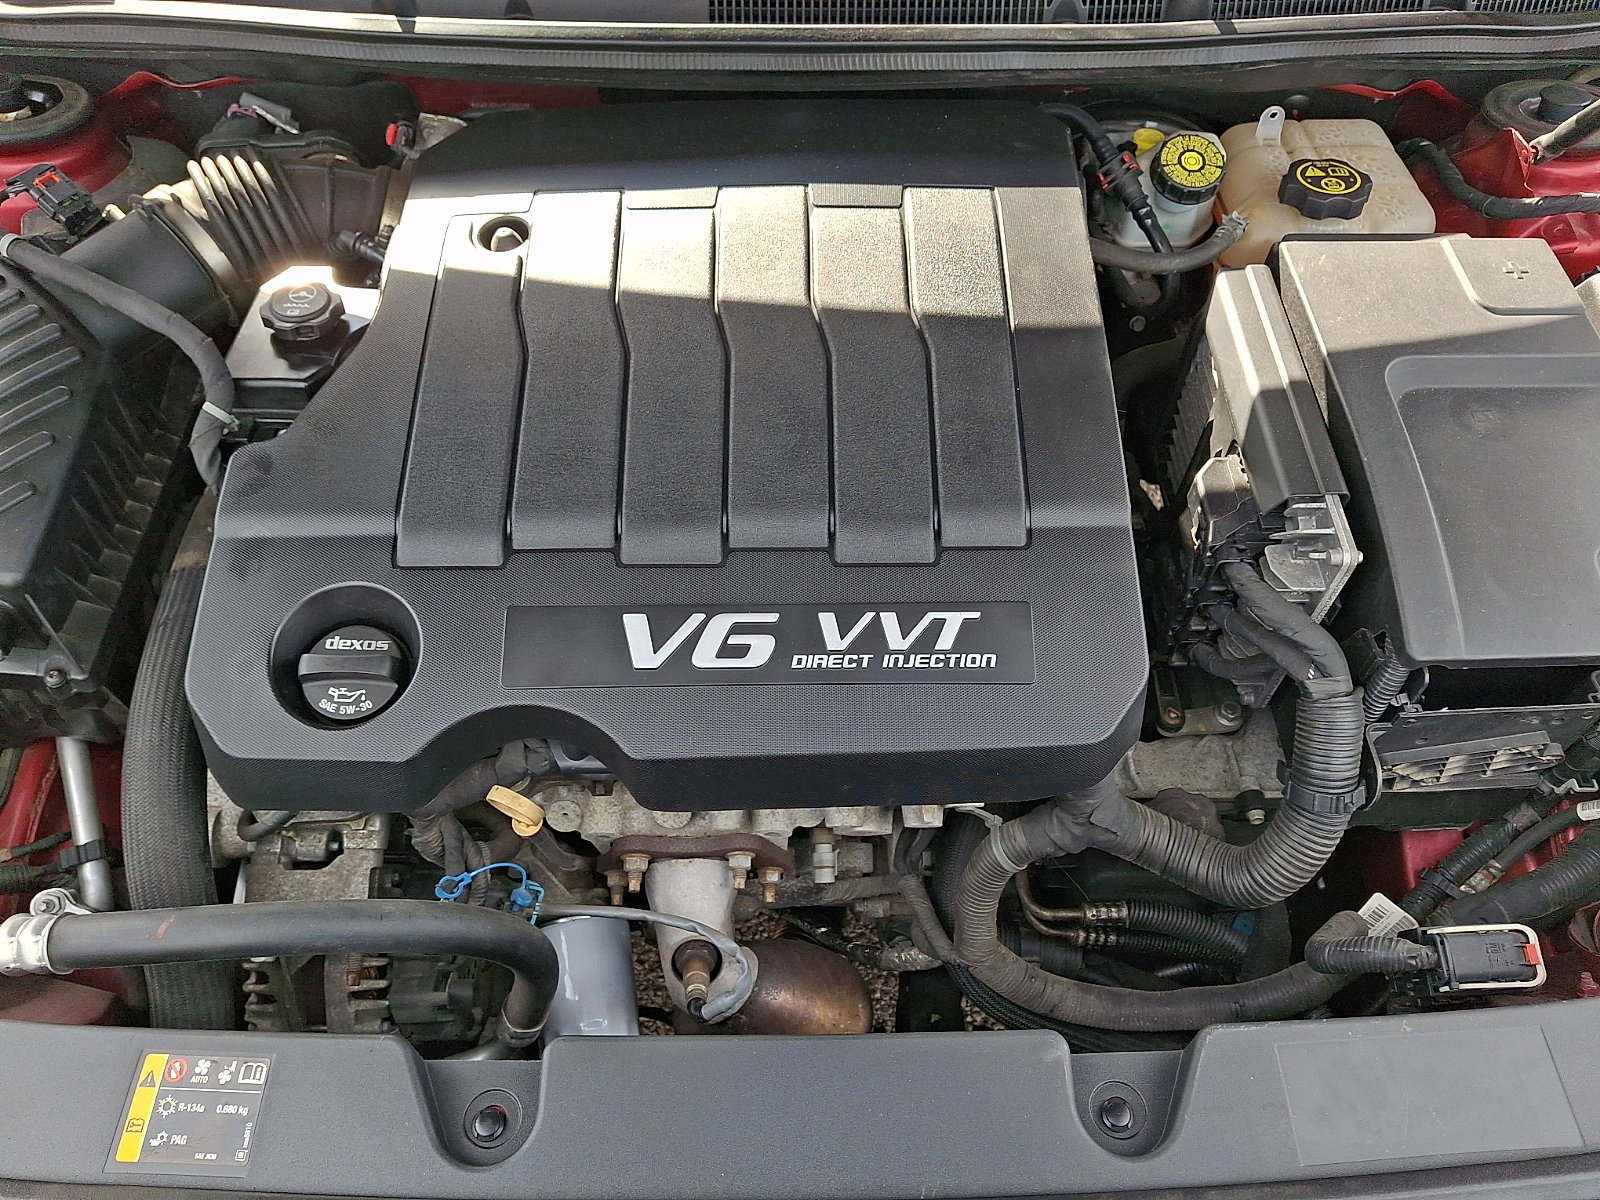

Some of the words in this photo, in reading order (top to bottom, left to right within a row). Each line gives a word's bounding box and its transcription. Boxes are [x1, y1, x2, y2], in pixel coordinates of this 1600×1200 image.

[325, 636, 392, 651] dexos
[622, 612, 780, 670] V6
[818, 611, 981, 652] VVT
[790, 653, 874, 669] DIRECT
[882, 653, 997, 669] INJECTION
[318, 698, 337, 713] SAE
[339, 700, 373, 714] 5W-30
[190, 1075, 208, 1083] AUTO
[177, 1102, 205, 1113] R-134a
[238, 1105, 249, 1116] kg
[169, 1134, 187, 1145] PAG
